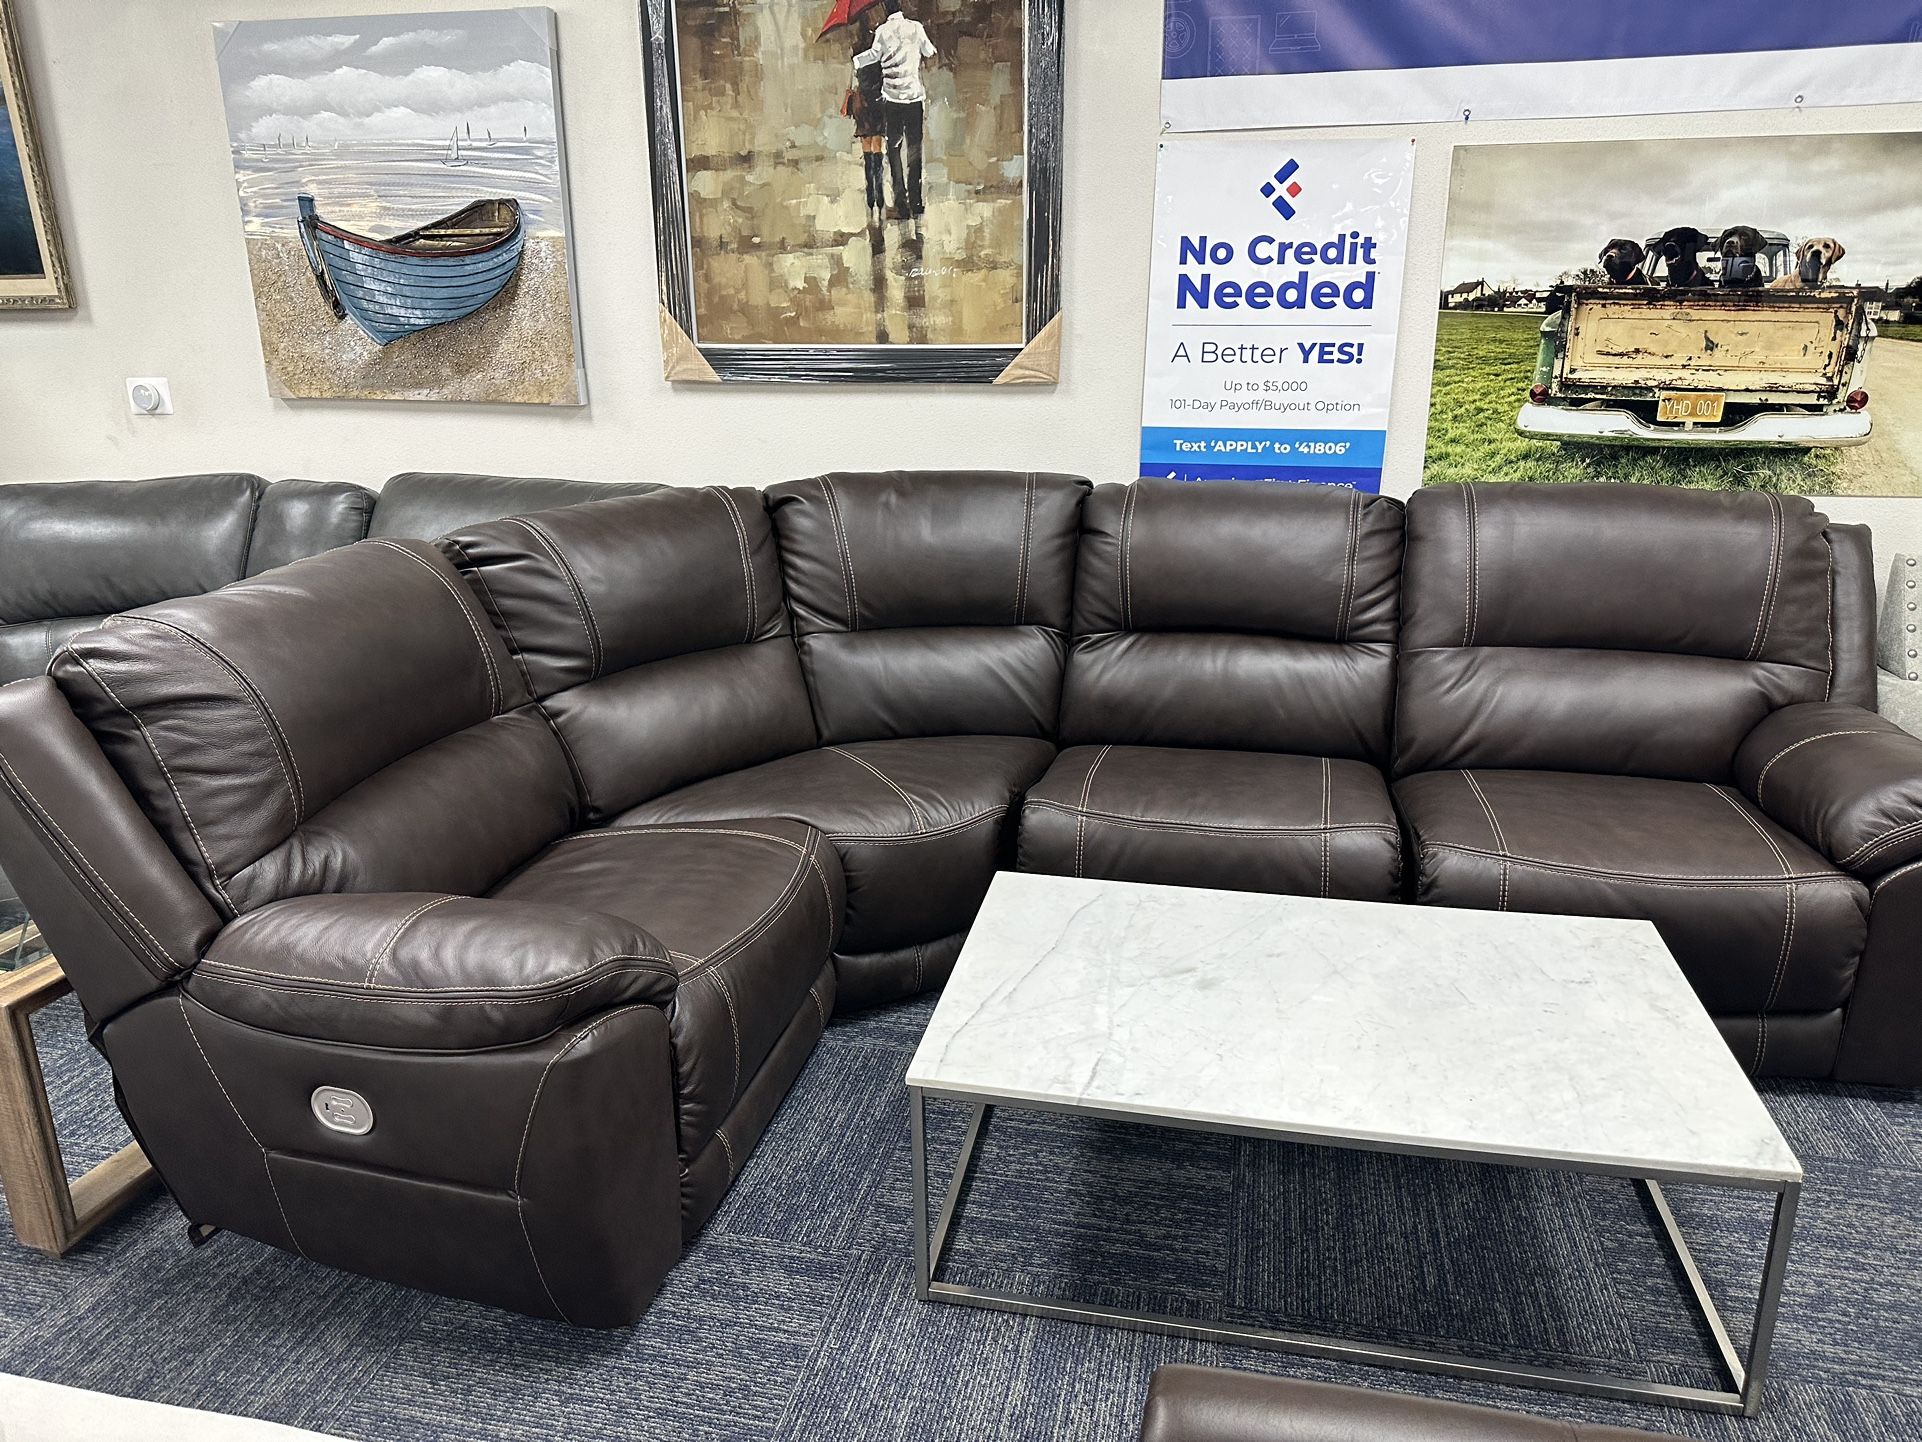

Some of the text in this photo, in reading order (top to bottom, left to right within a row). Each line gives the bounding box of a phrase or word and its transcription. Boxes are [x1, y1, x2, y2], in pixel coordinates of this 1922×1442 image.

[1179, 231, 1377, 265] No Credit
[1176, 271, 1376, 309] Needed
[1171, 341, 1364, 364] A Better YES!
[1223, 380, 1308, 393] Up to $5,000
[1169, 398, 1361, 413] 101-Day Payoff/Buyout Option
[1665, 399, 1718, 416] YHD 001
[1173, 440, 1206, 452] Text
[1273, 442, 1291, 454] to
